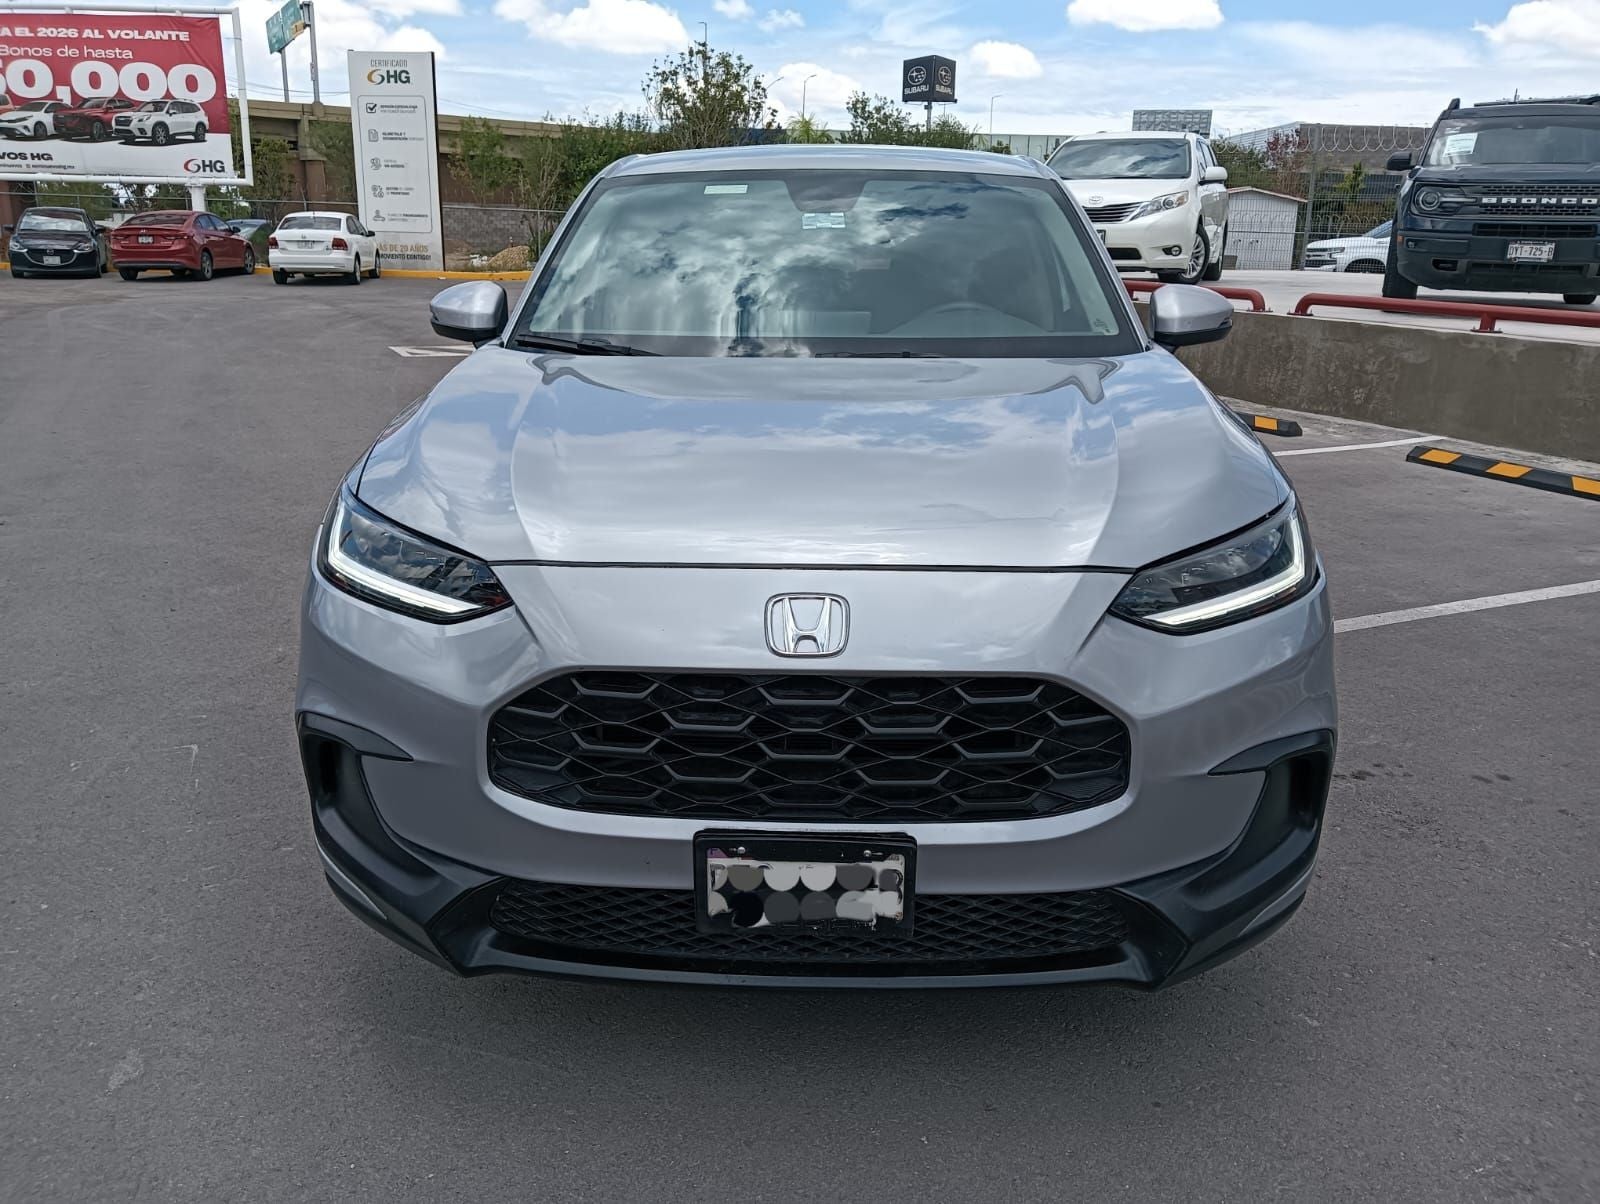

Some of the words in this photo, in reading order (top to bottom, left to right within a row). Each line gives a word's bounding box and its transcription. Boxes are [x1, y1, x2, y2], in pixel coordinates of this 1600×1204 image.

[14, 27, 34, 37] EL
[37, 27, 79, 38] 2026
[82, 29, 104, 39] AL
[107, 29, 190, 42] VOLANTE
[57, 45, 79, 57] de
[84, 45, 134, 59] hasta
[370, 59, 408, 68] CERTIFICADO
[0, 58, 217, 106] 0,000
[386, 70, 411, 84] HG
[904, 84, 929, 94] SUBARU
[936, 84, 953, 95] SUBARU
[30, 152, 53, 161] HG
[201, 159, 225, 173] HG
[1481, 197, 1598, 205] BRONCO
